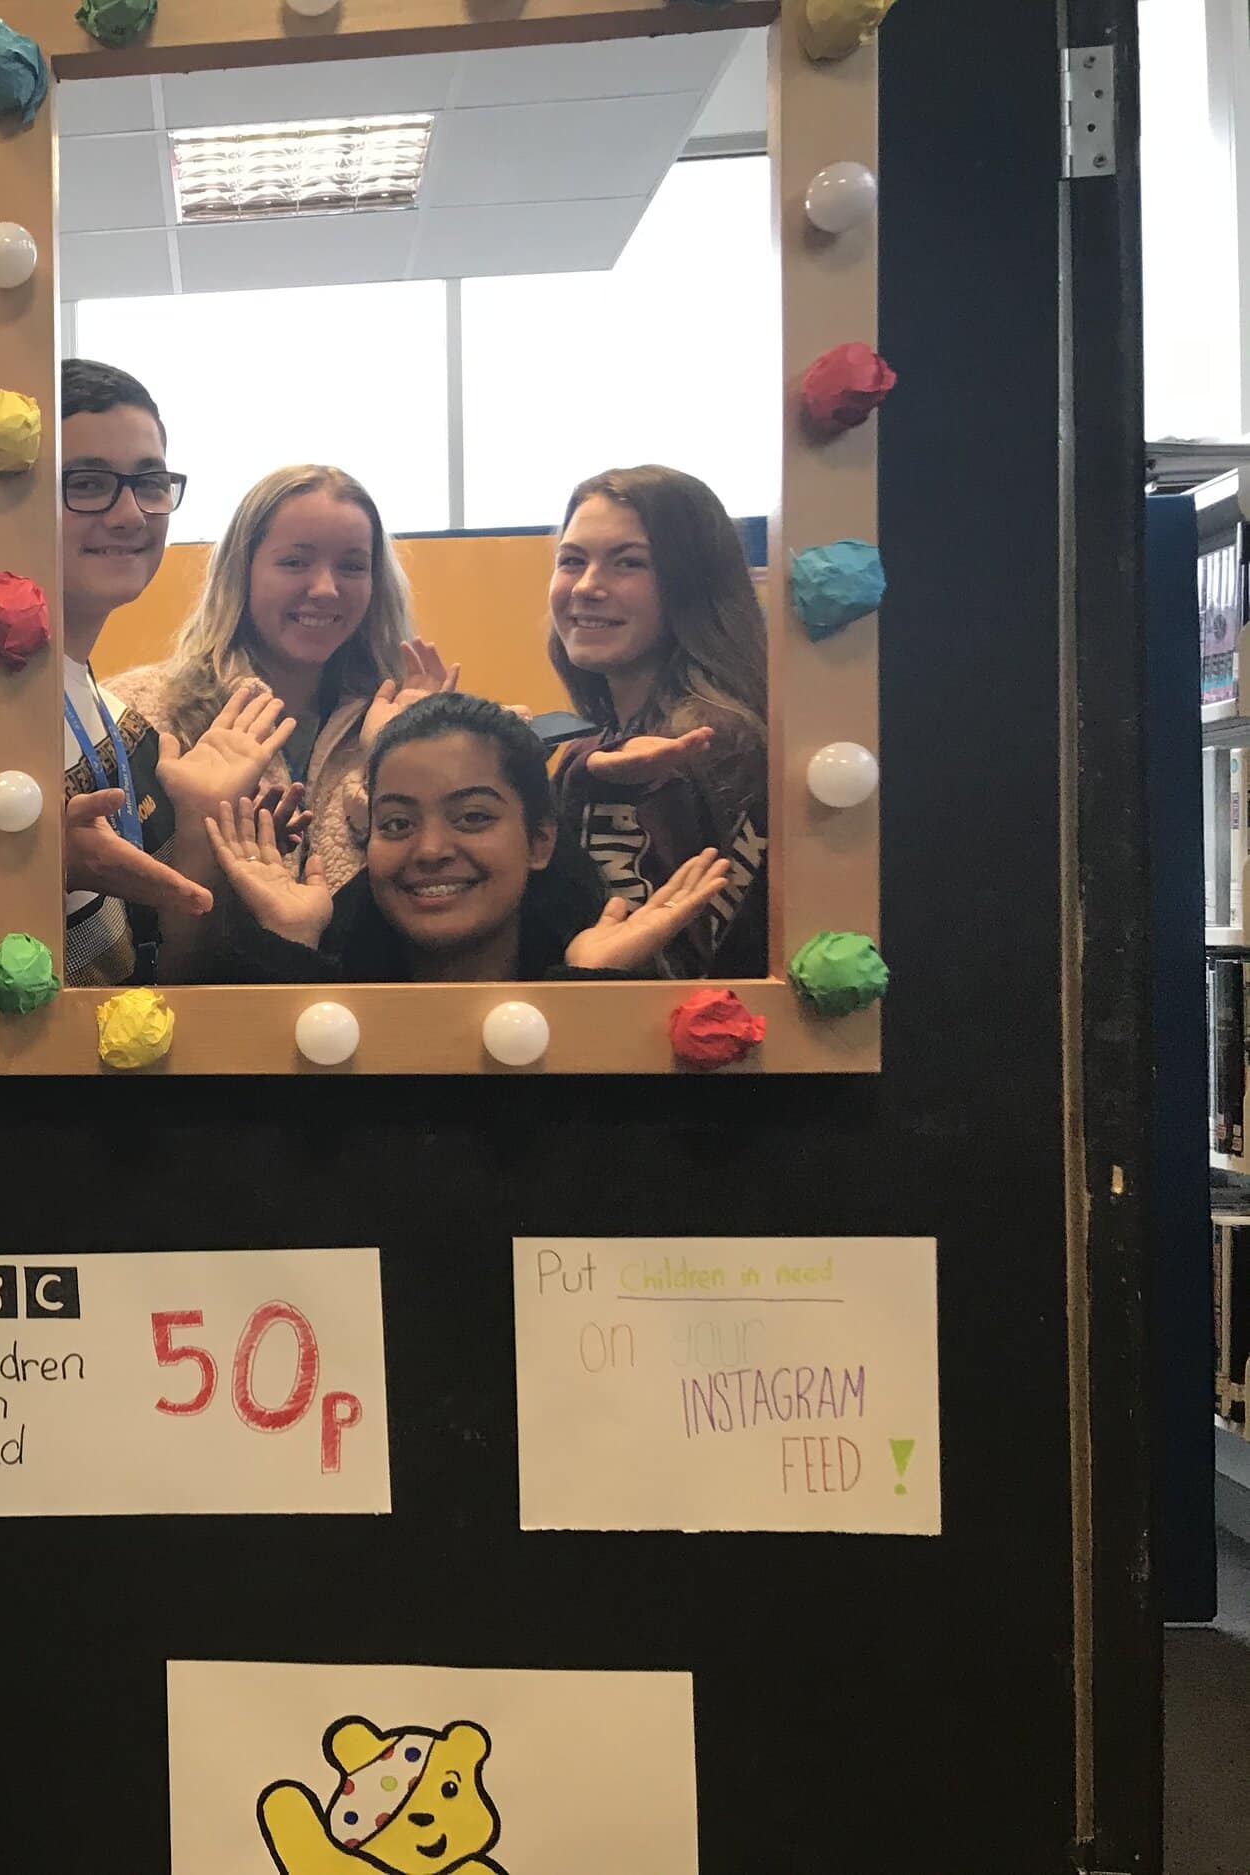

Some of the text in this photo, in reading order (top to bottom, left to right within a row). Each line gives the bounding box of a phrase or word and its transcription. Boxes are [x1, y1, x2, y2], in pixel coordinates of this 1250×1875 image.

[537, 1249, 834, 1295] Put Children in need
[579, 1321, 637, 1373] on
[682, 1365, 867, 1439] INSTAGRAM
[781, 1436, 861, 1495] FEED
